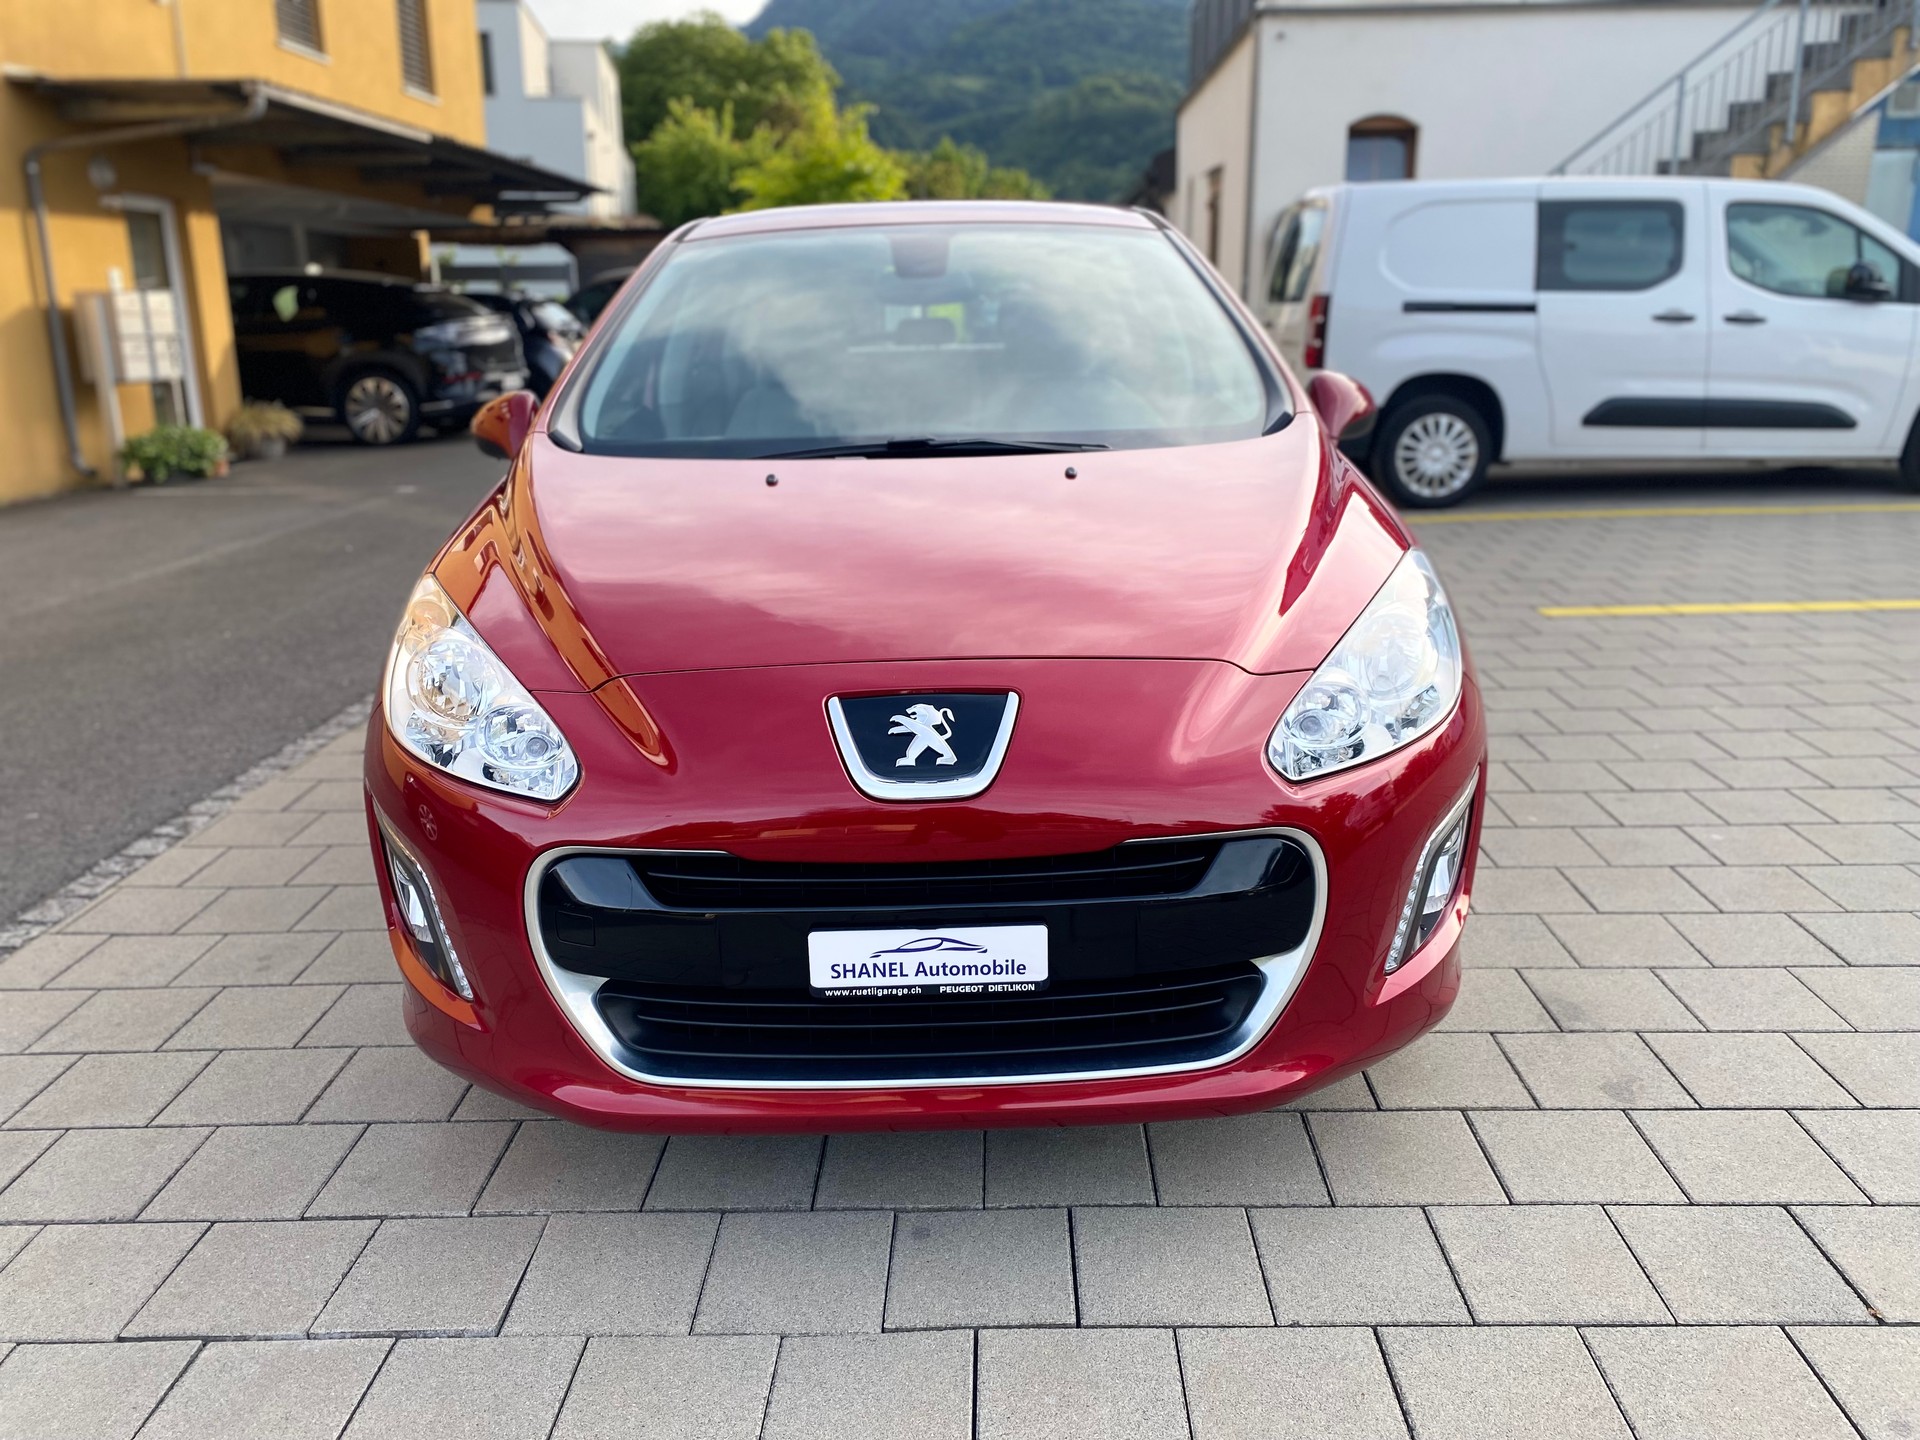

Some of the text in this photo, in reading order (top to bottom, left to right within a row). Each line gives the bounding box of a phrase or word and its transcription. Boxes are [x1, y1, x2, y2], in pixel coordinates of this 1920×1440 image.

[830, 959, 1027, 979] SHANEL Automobile
[825, 983, 1035, 997] www.ruetligarage.ch PEUGEOT DIETLIKON
